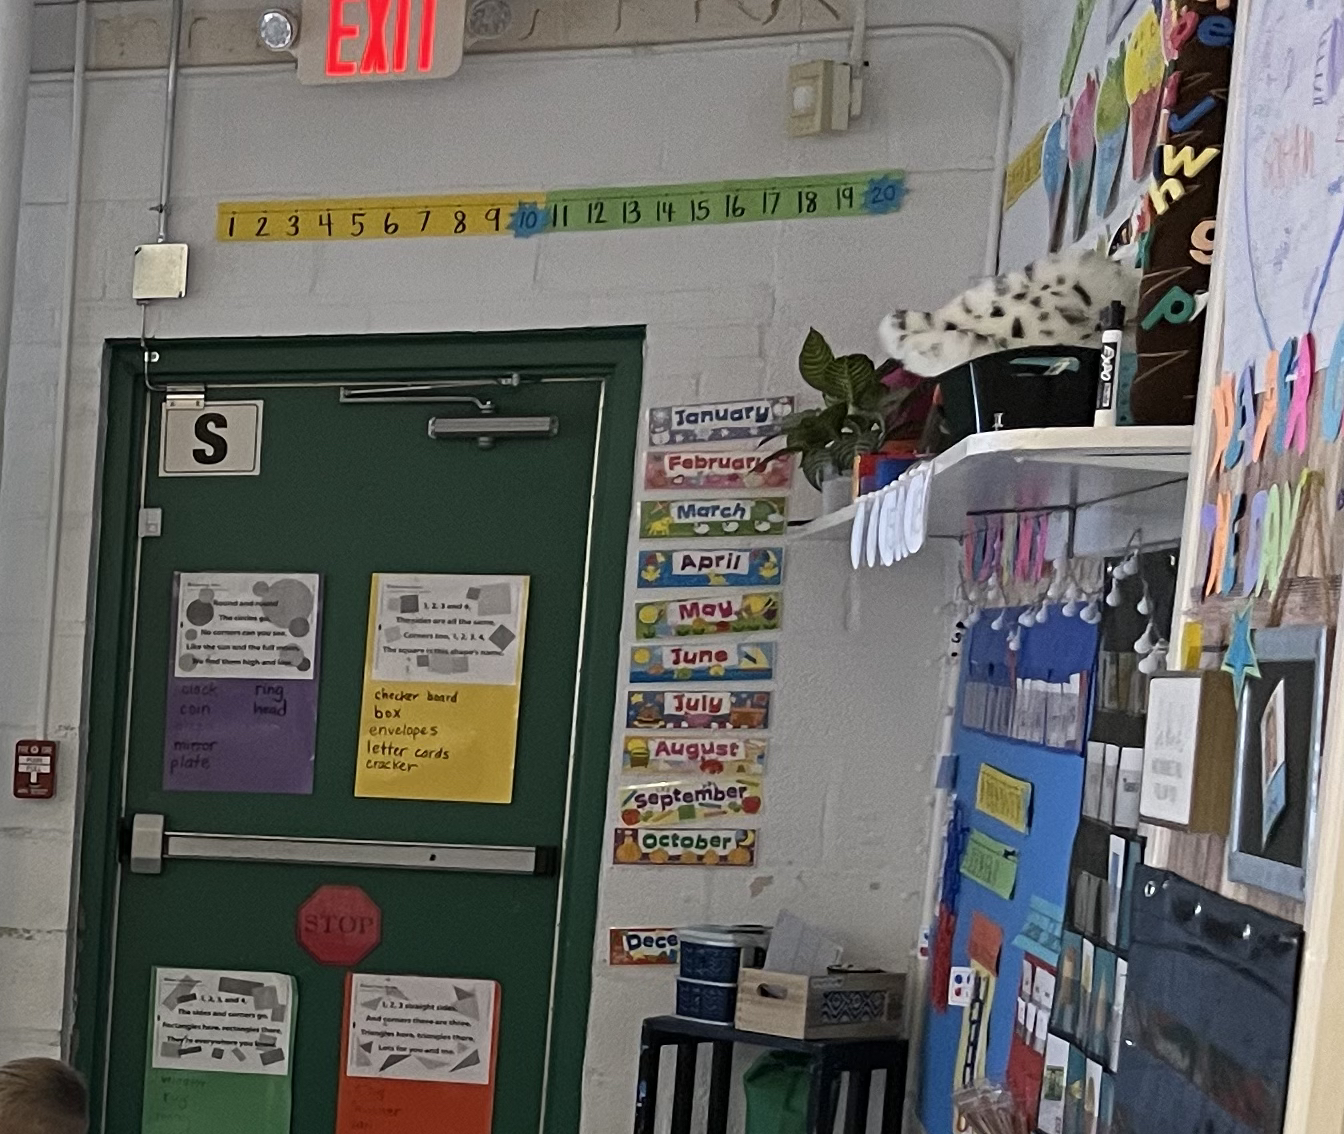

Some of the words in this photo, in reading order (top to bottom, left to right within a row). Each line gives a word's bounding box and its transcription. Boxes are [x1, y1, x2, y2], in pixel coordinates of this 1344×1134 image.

[228, 217, 235, 237] 1
[255, 217, 269, 236] 2
[286, 215, 300, 236] 3
[318, 213, 334, 236] 4
[350, 213, 365, 236] 5
[384, 212, 399, 235] 6
[417, 211, 430, 232] 7
[454, 211, 467, 234] 8
[485, 208, 501, 232] 9
[519, 210, 537, 230] 10
[552, 203, 568, 228] 11
[588, 202, 607, 223] 12
[622, 201, 641, 224] 13
[656, 200, 675, 222] 14
[691, 199, 710, 222] 15
[726, 195, 745, 218] 16
[762, 191, 781, 214] 17
[798, 190, 818, 214] 18
[836, 186, 853, 210] 19
[871, 186, 896, 203] 20
[674, 405, 772, 425] January
[192, 412, 228, 465] S
[668, 453, 765, 472] February
[677, 503, 746, 519] March
[680, 551, 742, 572] April
[678, 600, 733, 620] May
[670, 647, 729, 665] June
[255, 684, 285, 701] ring
[374, 687, 420, 701] checker
[427, 691, 459, 703] board
[179, 704, 212, 716] coin
[253, 699, 287, 717] head
[374, 705, 401, 719] box
[672, 693, 724, 713] July
[369, 724, 439, 739] envelopes
[367, 740, 409, 758] letter
[414, 747, 450, 760] cards
[654, 740, 740, 761] August
[170, 754, 211, 775] plate
[366, 759, 419, 773] cracker
[634, 783, 749, 810] September
[642, 832, 733, 850] October
[304, 914, 374, 936] STOP
